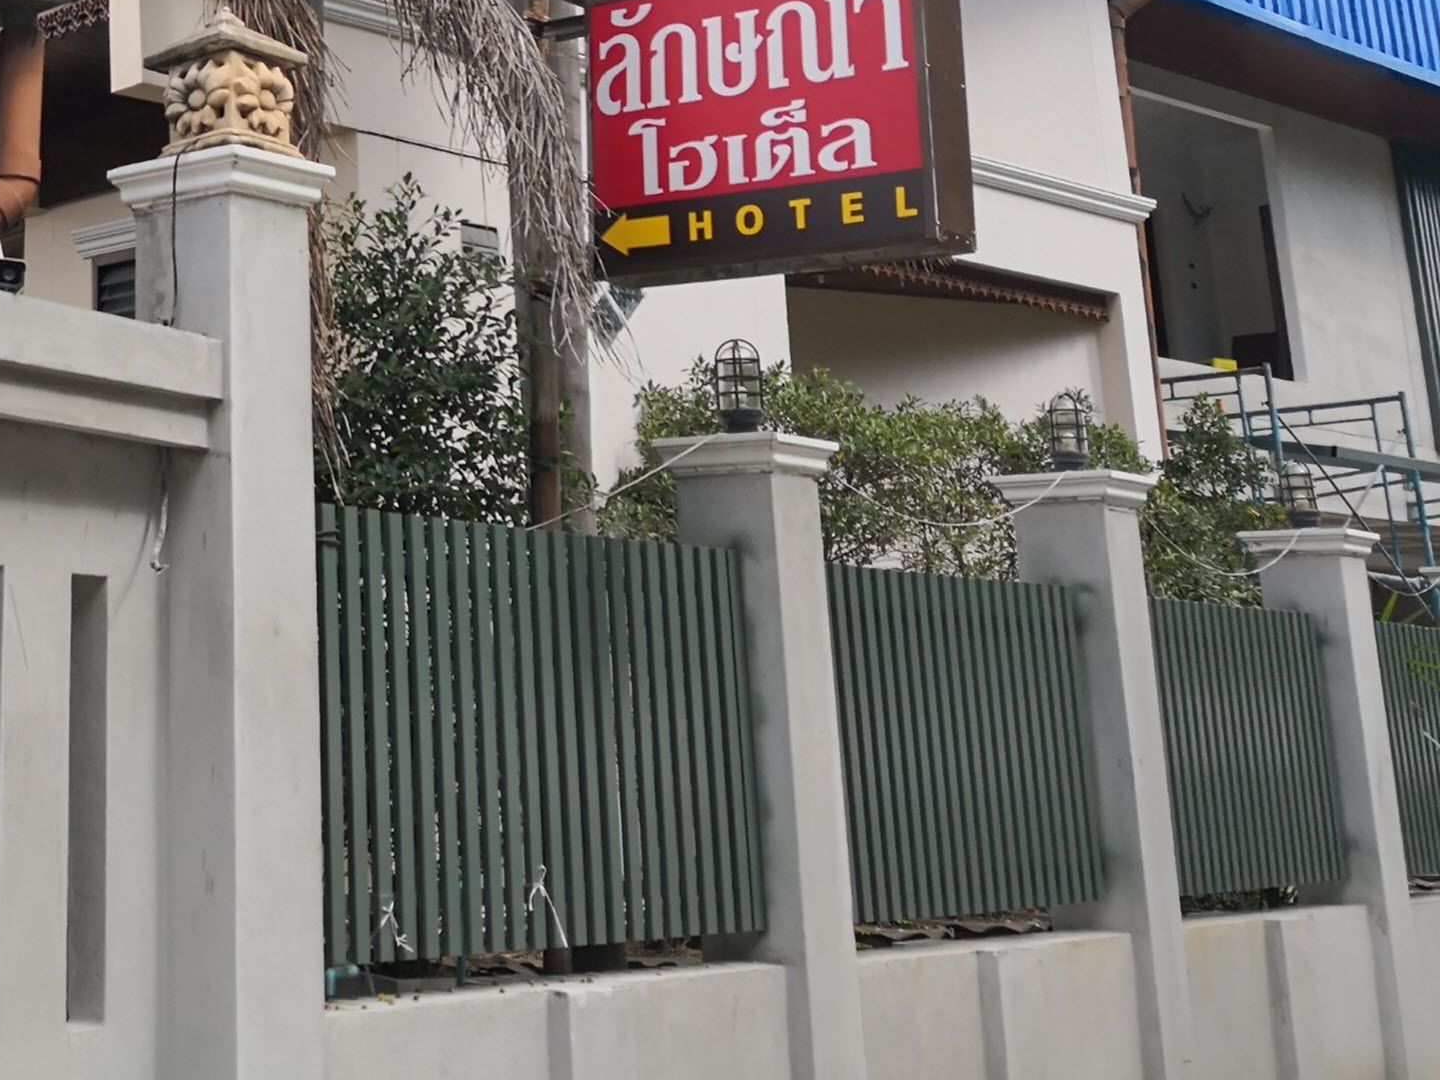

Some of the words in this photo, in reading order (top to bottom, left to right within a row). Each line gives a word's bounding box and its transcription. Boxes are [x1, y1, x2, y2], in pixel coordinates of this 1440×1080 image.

[628, 98, 877, 196] โฮเต็ล
[688, 186, 918, 241] HOTEL
